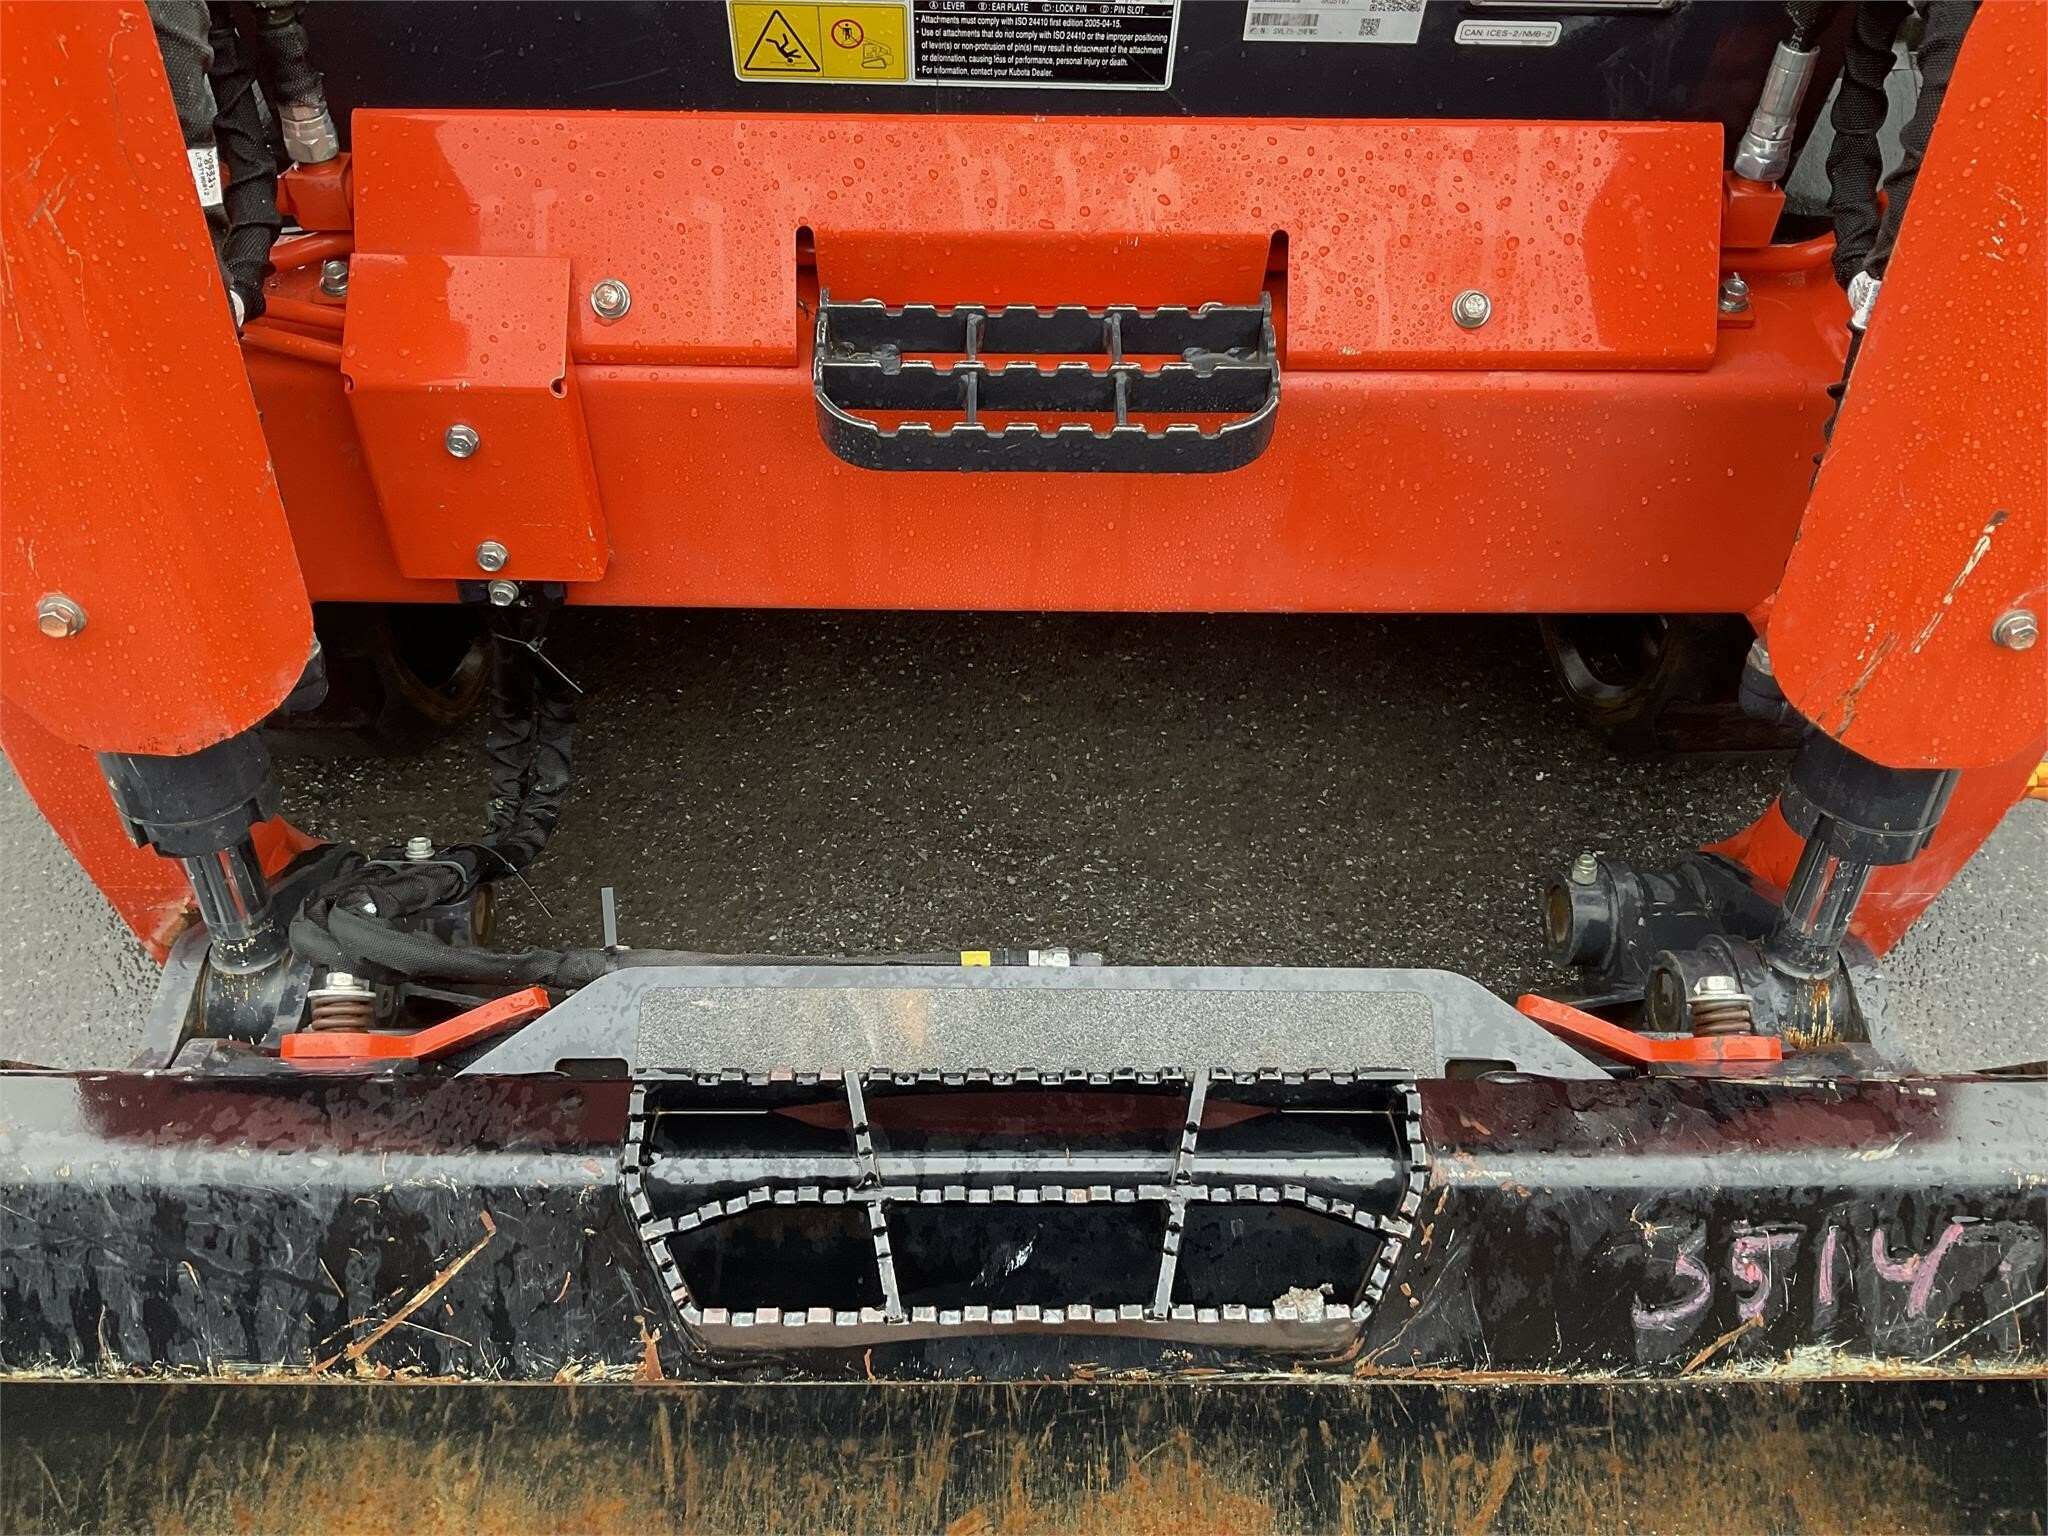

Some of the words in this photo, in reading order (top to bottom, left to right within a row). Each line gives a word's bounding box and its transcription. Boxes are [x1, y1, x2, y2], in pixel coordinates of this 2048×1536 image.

[942, 2, 965, 10] LEVER
[992, 3, 1006, 11] EAR
[1007, 3, 1029, 12] PLATE
[1056, 4, 1074, 13] LOCK
[1075, 5, 1088, 13] PIN
[1114, 5, 1126, 14] PIN
[1126, 6, 1145, 14] SLOT
[921, 15, 960, 24] Attachments
[977, 16, 999, 26] comply
[1001, 17, 1014, 25] with
[1015, 17, 1027, 26] ISO
[1028, 18, 1048, 26] 24410
[1050, 18, 1061, 26] first
[1062, 18, 1083, 27] edition
[1084, 19, 1122, 28] 2005-04-15.
[921, 28, 934, 36] Use
[942, 29, 980, 38] attachments
[1016, 31, 1038, 40] comply
[1053, 31, 1065, 39] ISO
[1066, 32, 1086, 40] 24410
[1095, 32, 1105, 40] the
[1106, 32, 1134, 42] improper
[1134, 33, 1168, 44] positioning
[1486, 30, 1552, 38] ICES-2/NMB-2
[922, 41, 928, 49] of
[929, 41, 952, 51] lever(s)
[962, 43, 1005, 52] non-protrusion
[1014, 44, 1032, 52] pin(s)
[1033, 45, 1046, 53] may
[1073, 45, 1109, 53] detachment
[1118, 46, 1128, 54] the
[1129, 46, 1163, 54] attachment
[969, 56, 992, 65] causing
[993, 55, 1007, 64] loss
[1007, 55, 1014, 63] of
[1015, 56, 1054, 65] performance,
[1056, 57, 1082, 66] personal
[1084, 58, 1100, 67] injury
[1110, 58, 1128, 66] death.
[922, 65, 933, 74] For
[934, 66, 969, 76] information,
[970, 67, 993, 76] contact
[993, 68, 1007, 77] your
[1009, 68, 1030, 76] Kubota
[1032, 69, 1054, 77] Dealer.
